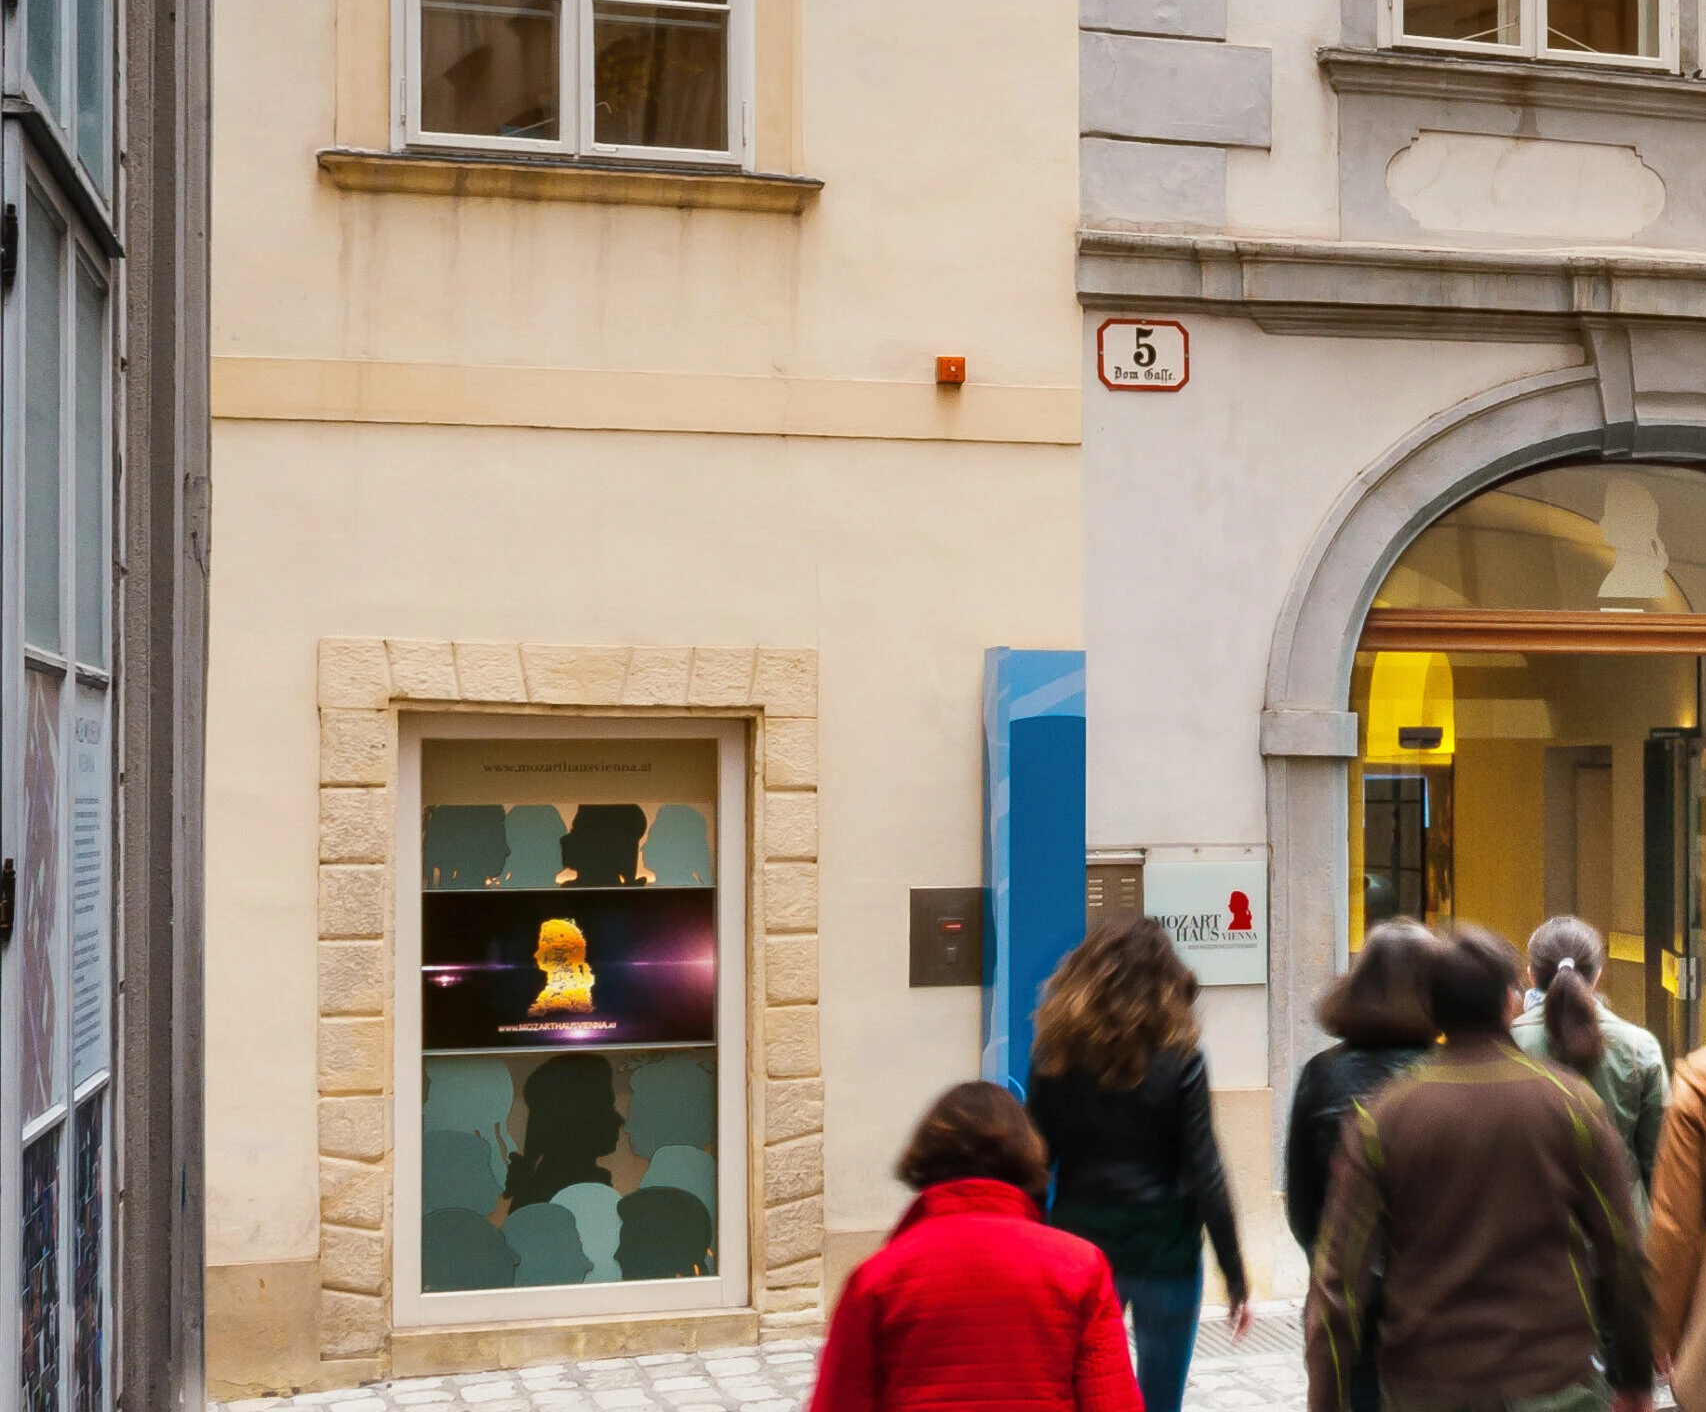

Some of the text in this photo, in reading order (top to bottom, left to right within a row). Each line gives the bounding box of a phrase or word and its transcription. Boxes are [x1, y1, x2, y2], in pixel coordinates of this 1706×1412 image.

[1133, 327, 1157, 368] 5
[1114, 366, 1139, 380] Dom
[483, 760, 652, 773] www.mozarthausvienna.at
[1153, 914, 1222, 930] MOZART
[1176, 926, 1258, 942] HAUS VIENNA
